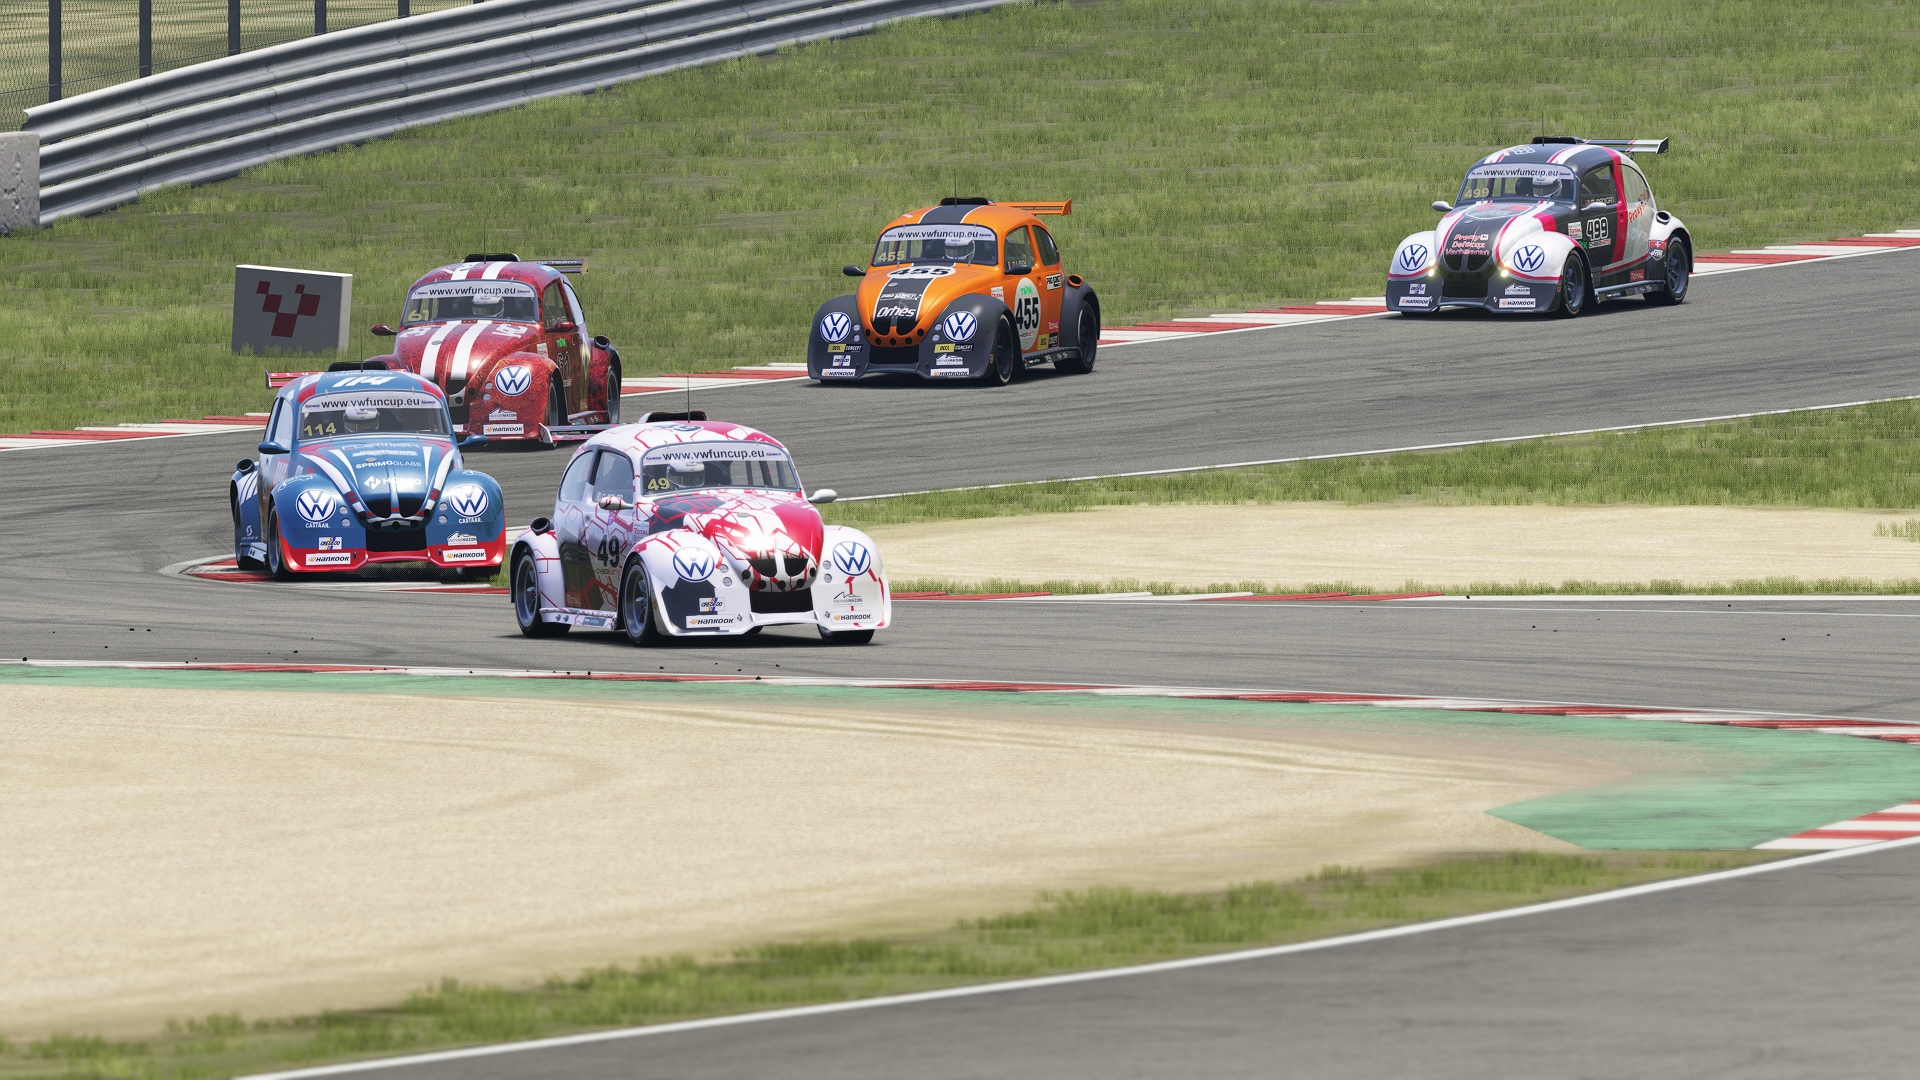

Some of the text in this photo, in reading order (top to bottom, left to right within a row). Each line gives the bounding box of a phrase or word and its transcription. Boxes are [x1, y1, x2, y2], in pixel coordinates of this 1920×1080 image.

[1483, 168, 1559, 177] www.vwfuncup.eu
[1464, 188, 1489, 198] 499
[897, 230, 979, 239] www.vwfuncup.eu
[1586, 216, 1609, 241] 499
[877, 251, 905, 262] 455
[1400, 244, 1427, 271] VW
[1513, 245, 1545, 272] VW
[890, 268, 951, 276] 455
[429, 286, 516, 296] www.vwfuncup.eu
[408, 309, 429, 321] 61
[1016, 297, 1039, 329] 455
[820, 311, 851, 343] VW
[943, 311, 977, 342] VW
[332, 376, 398, 388] 114
[495, 365, 531, 396] VW
[321, 398, 420, 409] www.vwfuncup.eu
[303, 422, 337, 437] 114
[662, 449, 765, 461] www.vwfuncup.eu
[647, 478, 670, 491] 49
[296, 489, 336, 522] VW
[597, 535, 619, 568] 49
[833, 541, 870, 576] VW
[673, 547, 714, 582] W
